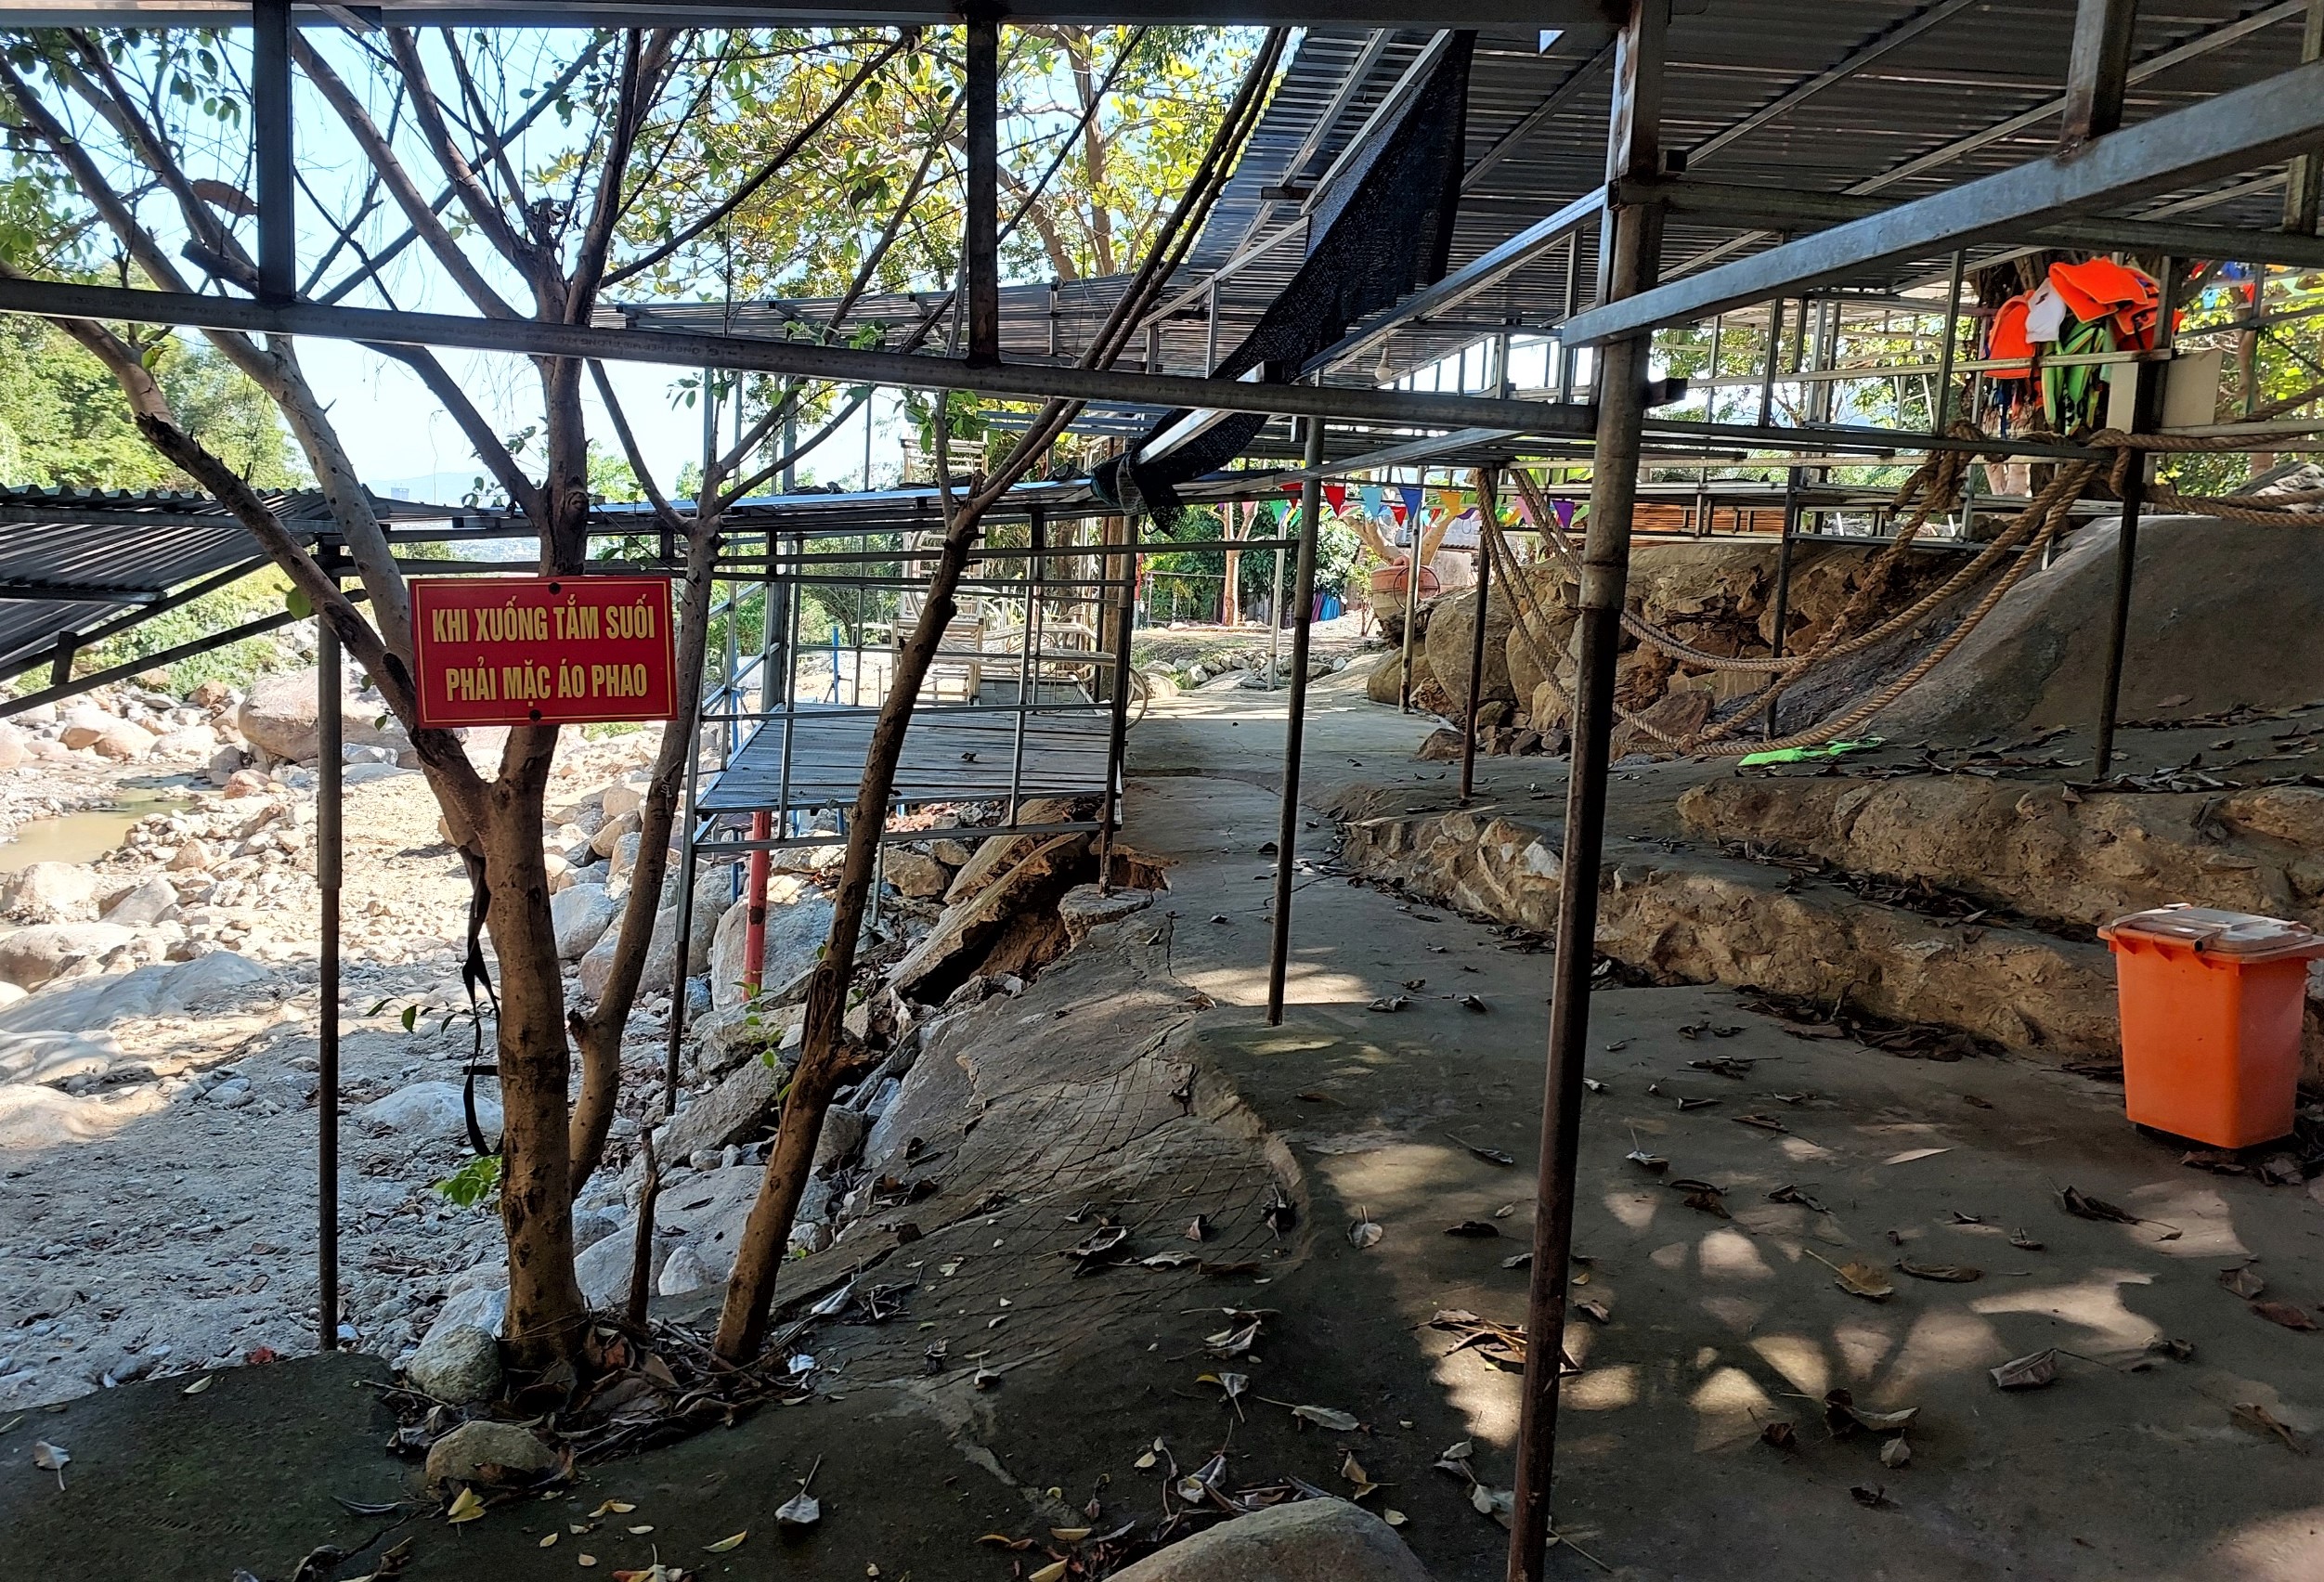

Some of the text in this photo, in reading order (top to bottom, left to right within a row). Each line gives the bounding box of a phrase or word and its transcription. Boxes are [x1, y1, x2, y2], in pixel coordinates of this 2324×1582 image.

[432, 593, 656, 642] KHI XUỐNG TẮM SUỐI
[446, 655, 648, 707] PHẢI MẶC ÁO PHAO
